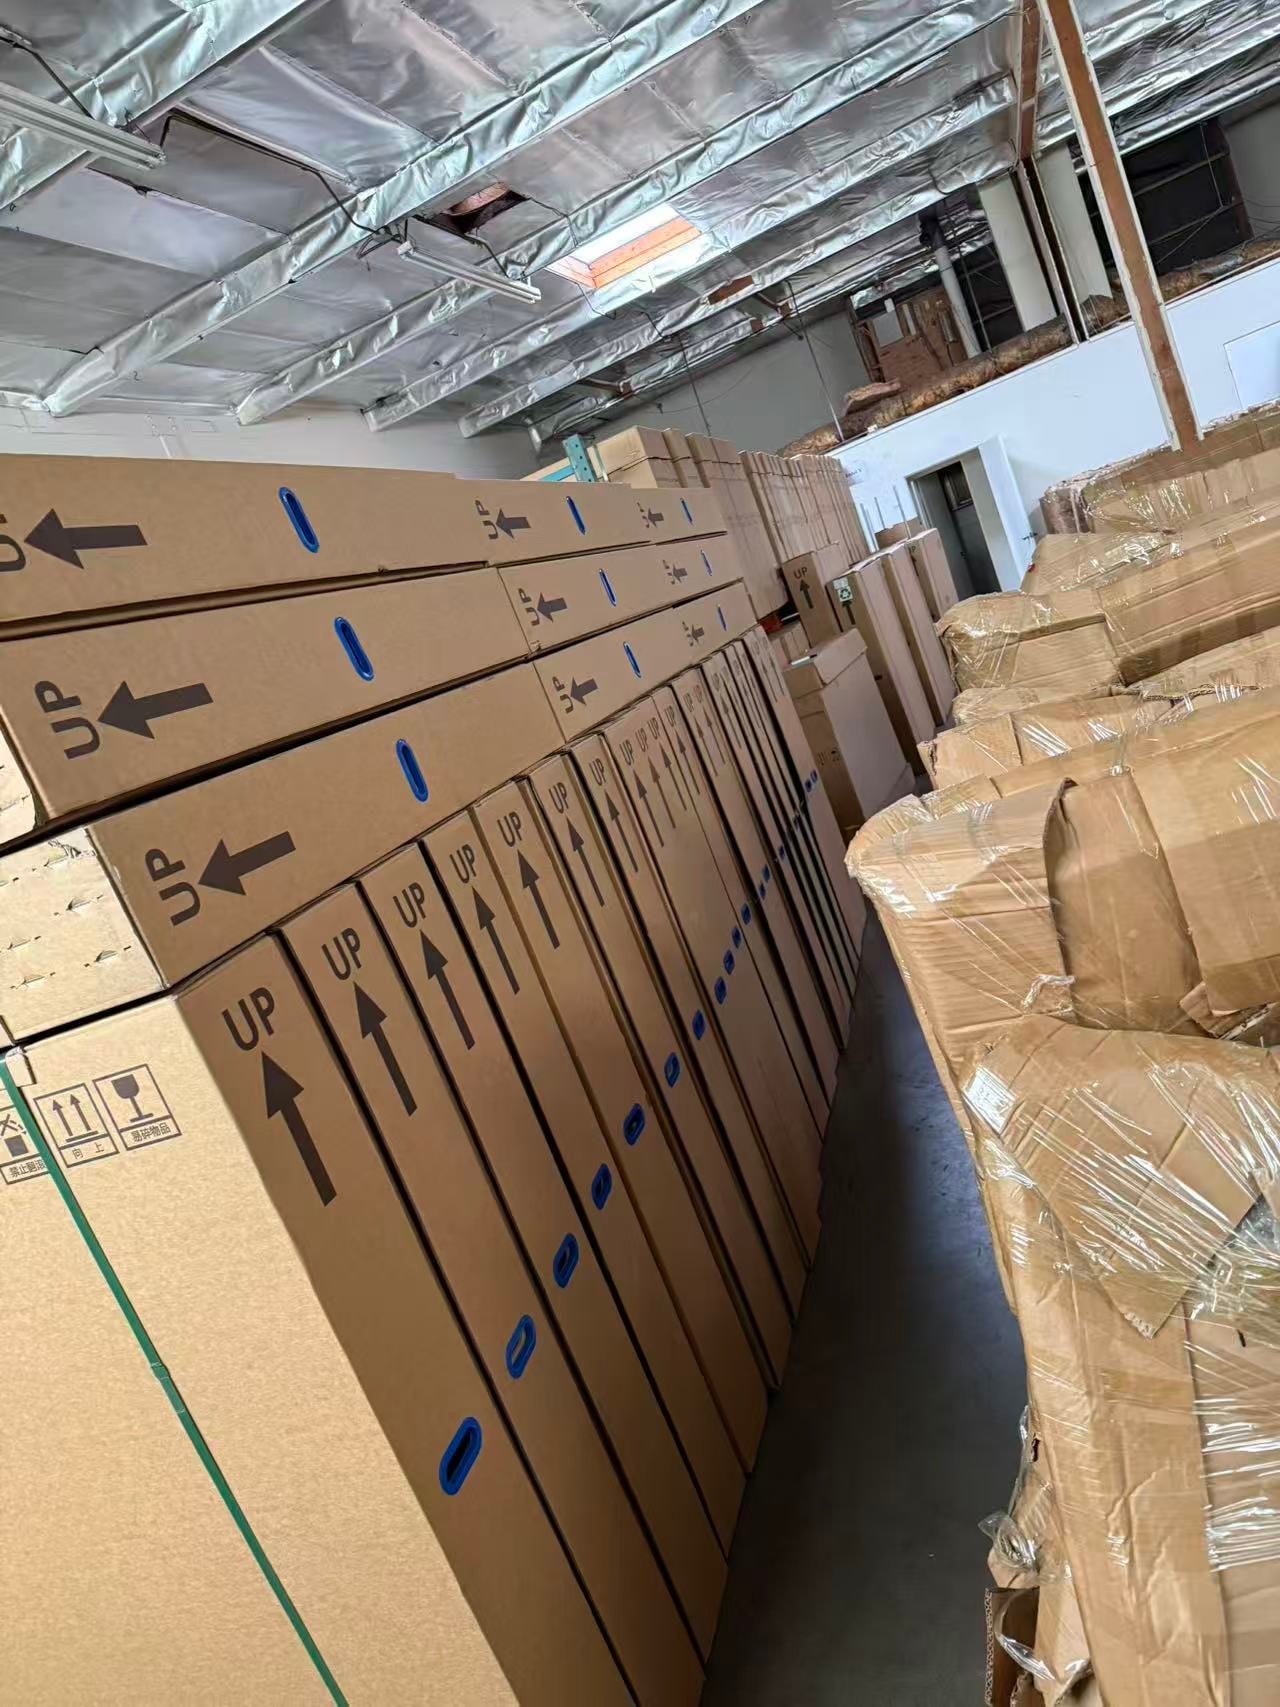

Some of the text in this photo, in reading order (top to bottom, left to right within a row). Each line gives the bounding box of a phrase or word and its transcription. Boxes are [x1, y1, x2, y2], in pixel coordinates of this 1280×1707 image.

[474, 499, 499, 540] UP
[0, 513, 27, 573] U
[793, 567, 808, 580] UP
[517, 587, 541, 626] UP
[552, 676, 575, 714] UP
[34, 680, 100, 760] UP
[648, 717, 659, 740] UP
[619, 739, 635, 766] UP
[635, 727, 648, 753] UP
[589, 758, 607, 786] UP
[548, 782, 570, 814] UP
[497, 811, 523, 848] UP
[449, 843, 478, 884] UP
[145, 847, 201, 927] UP
[392, 882, 427, 928] UP
[321, 927, 362, 981] UP
[221, 986, 276, 1052] UP
[72, 1142, 105, 1160] 向 上
[131, 1122, 171, 1142] 易碎物品
